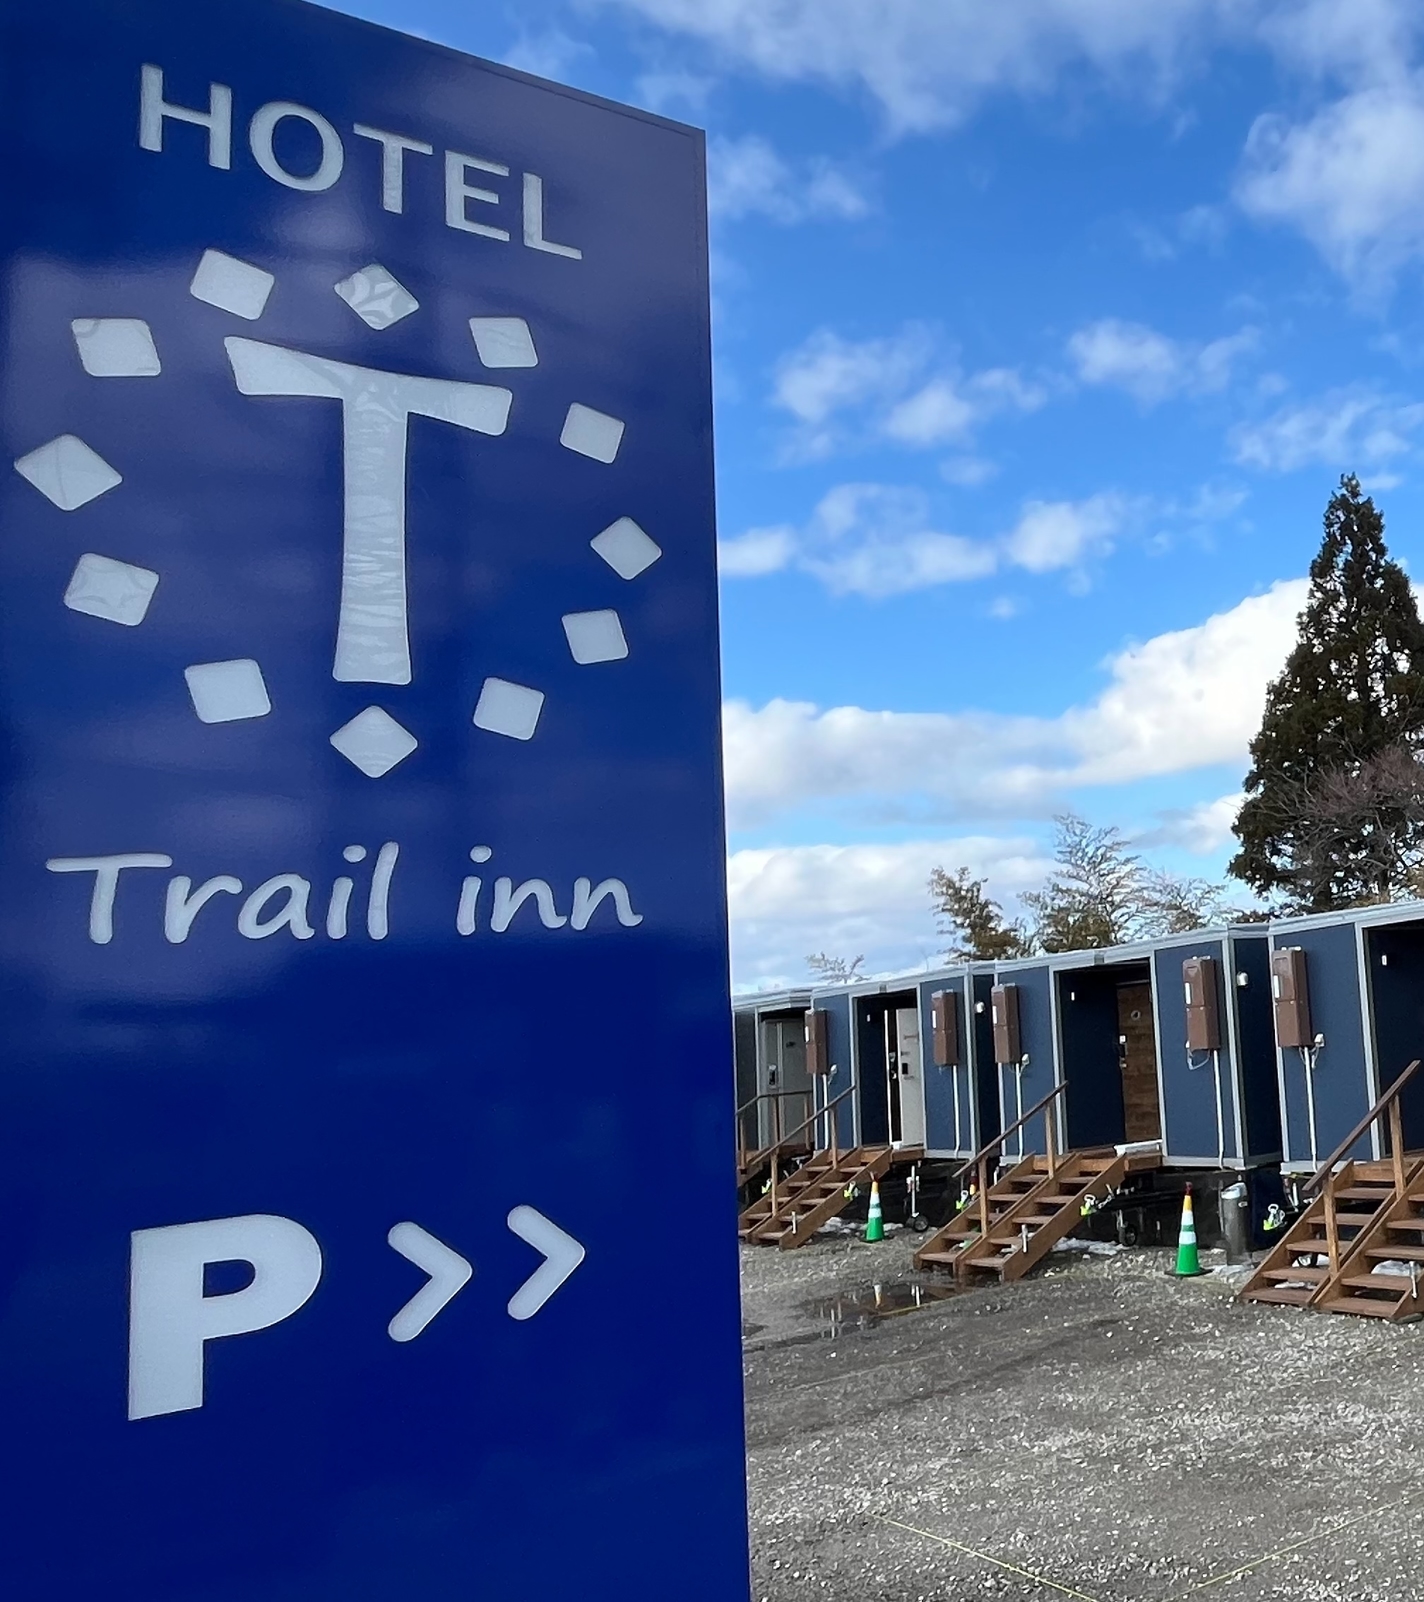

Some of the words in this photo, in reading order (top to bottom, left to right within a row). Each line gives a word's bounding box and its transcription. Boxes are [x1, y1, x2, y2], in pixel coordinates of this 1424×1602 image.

[138, 62, 584, 261] HOTEL
[223, 335, 513, 686] T
[45, 841, 399, 944] Trail
[456, 844, 643, 936] inn
[128, 1213, 322, 1422] P
